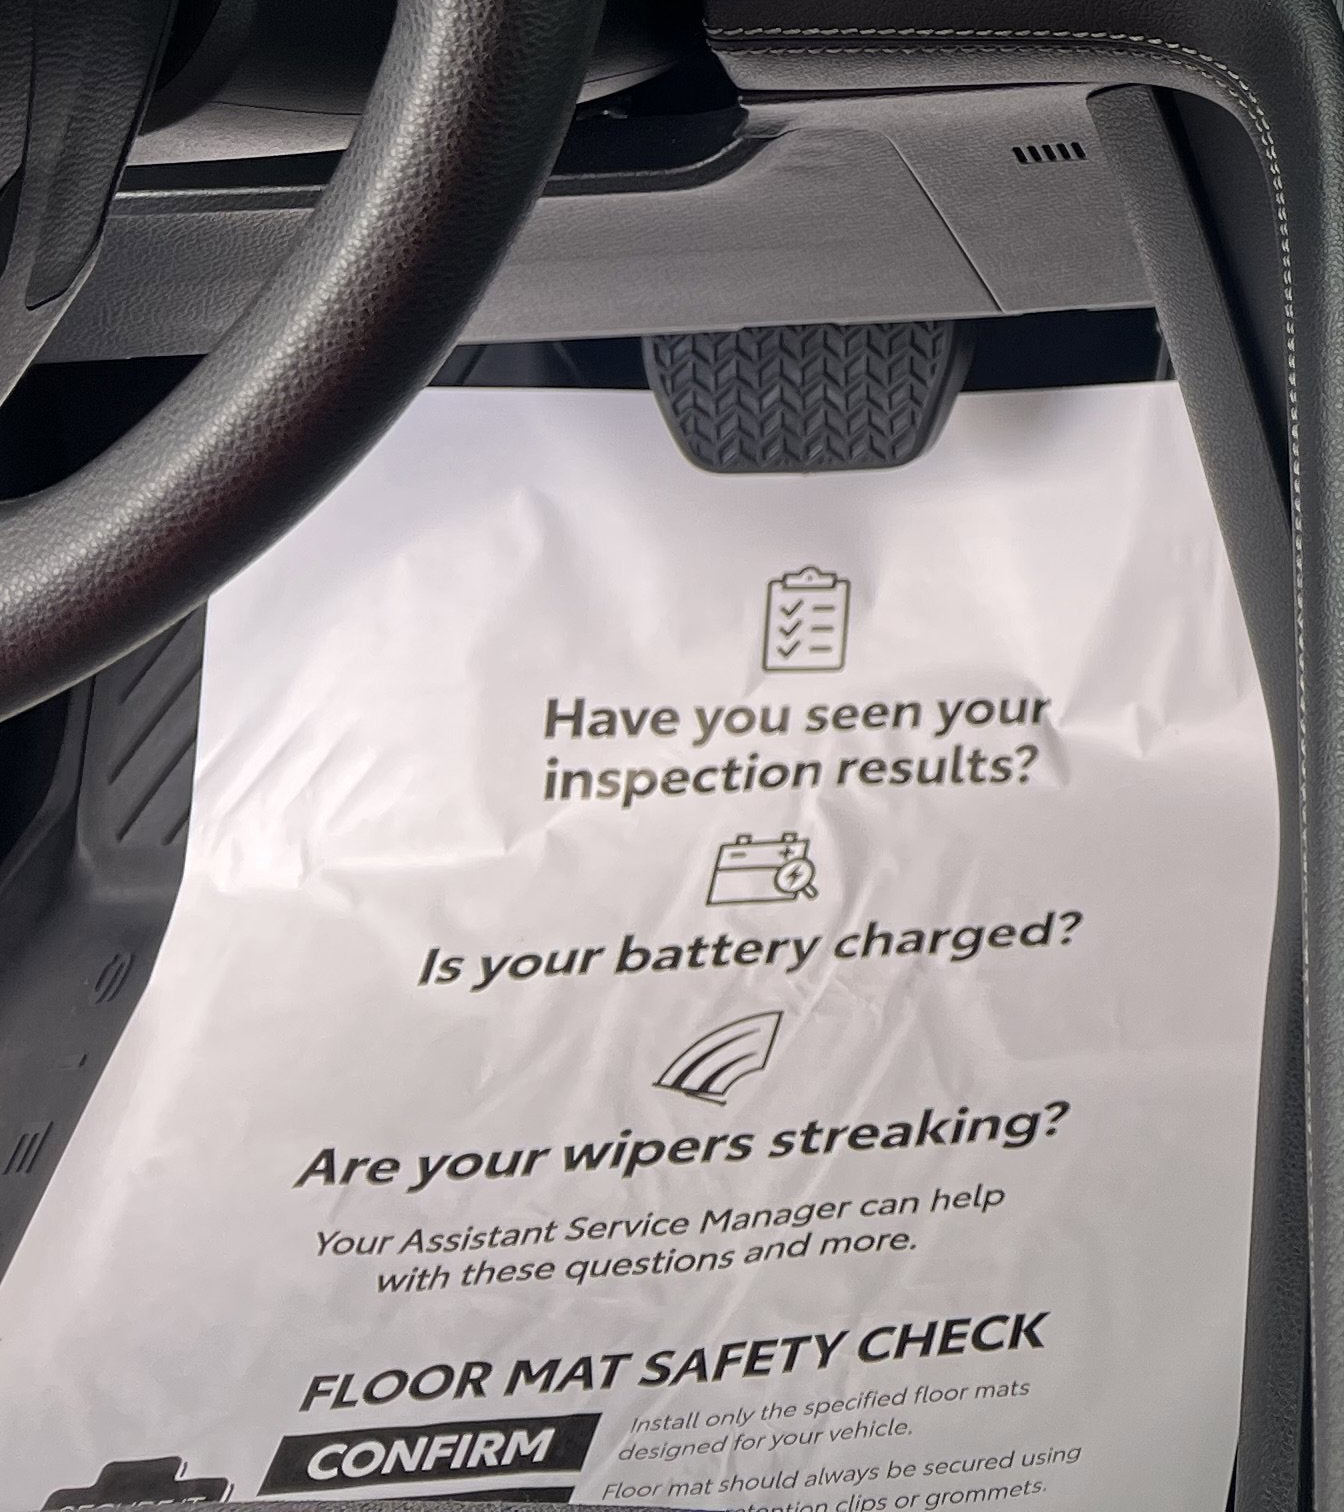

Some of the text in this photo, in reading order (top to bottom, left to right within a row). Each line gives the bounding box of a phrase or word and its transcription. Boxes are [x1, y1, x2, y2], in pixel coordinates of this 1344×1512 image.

[543, 693, 1052, 746] Have you seen your
[543, 744, 1039, 807] inspection results?
[417, 911, 1084, 992] Is your battery charged?
[292, 1100, 1070, 1194] Are your wipers streaking?
[315, 1182, 1006, 1259] Your Assistant Service Manager can help
[299, 1310, 1051, 1412] FLOOR MAT SAFETY CHECK
[630, 1380, 1030, 1433] Install only the specified floor mats
[306, 1428, 556, 1481] CONFIRM
